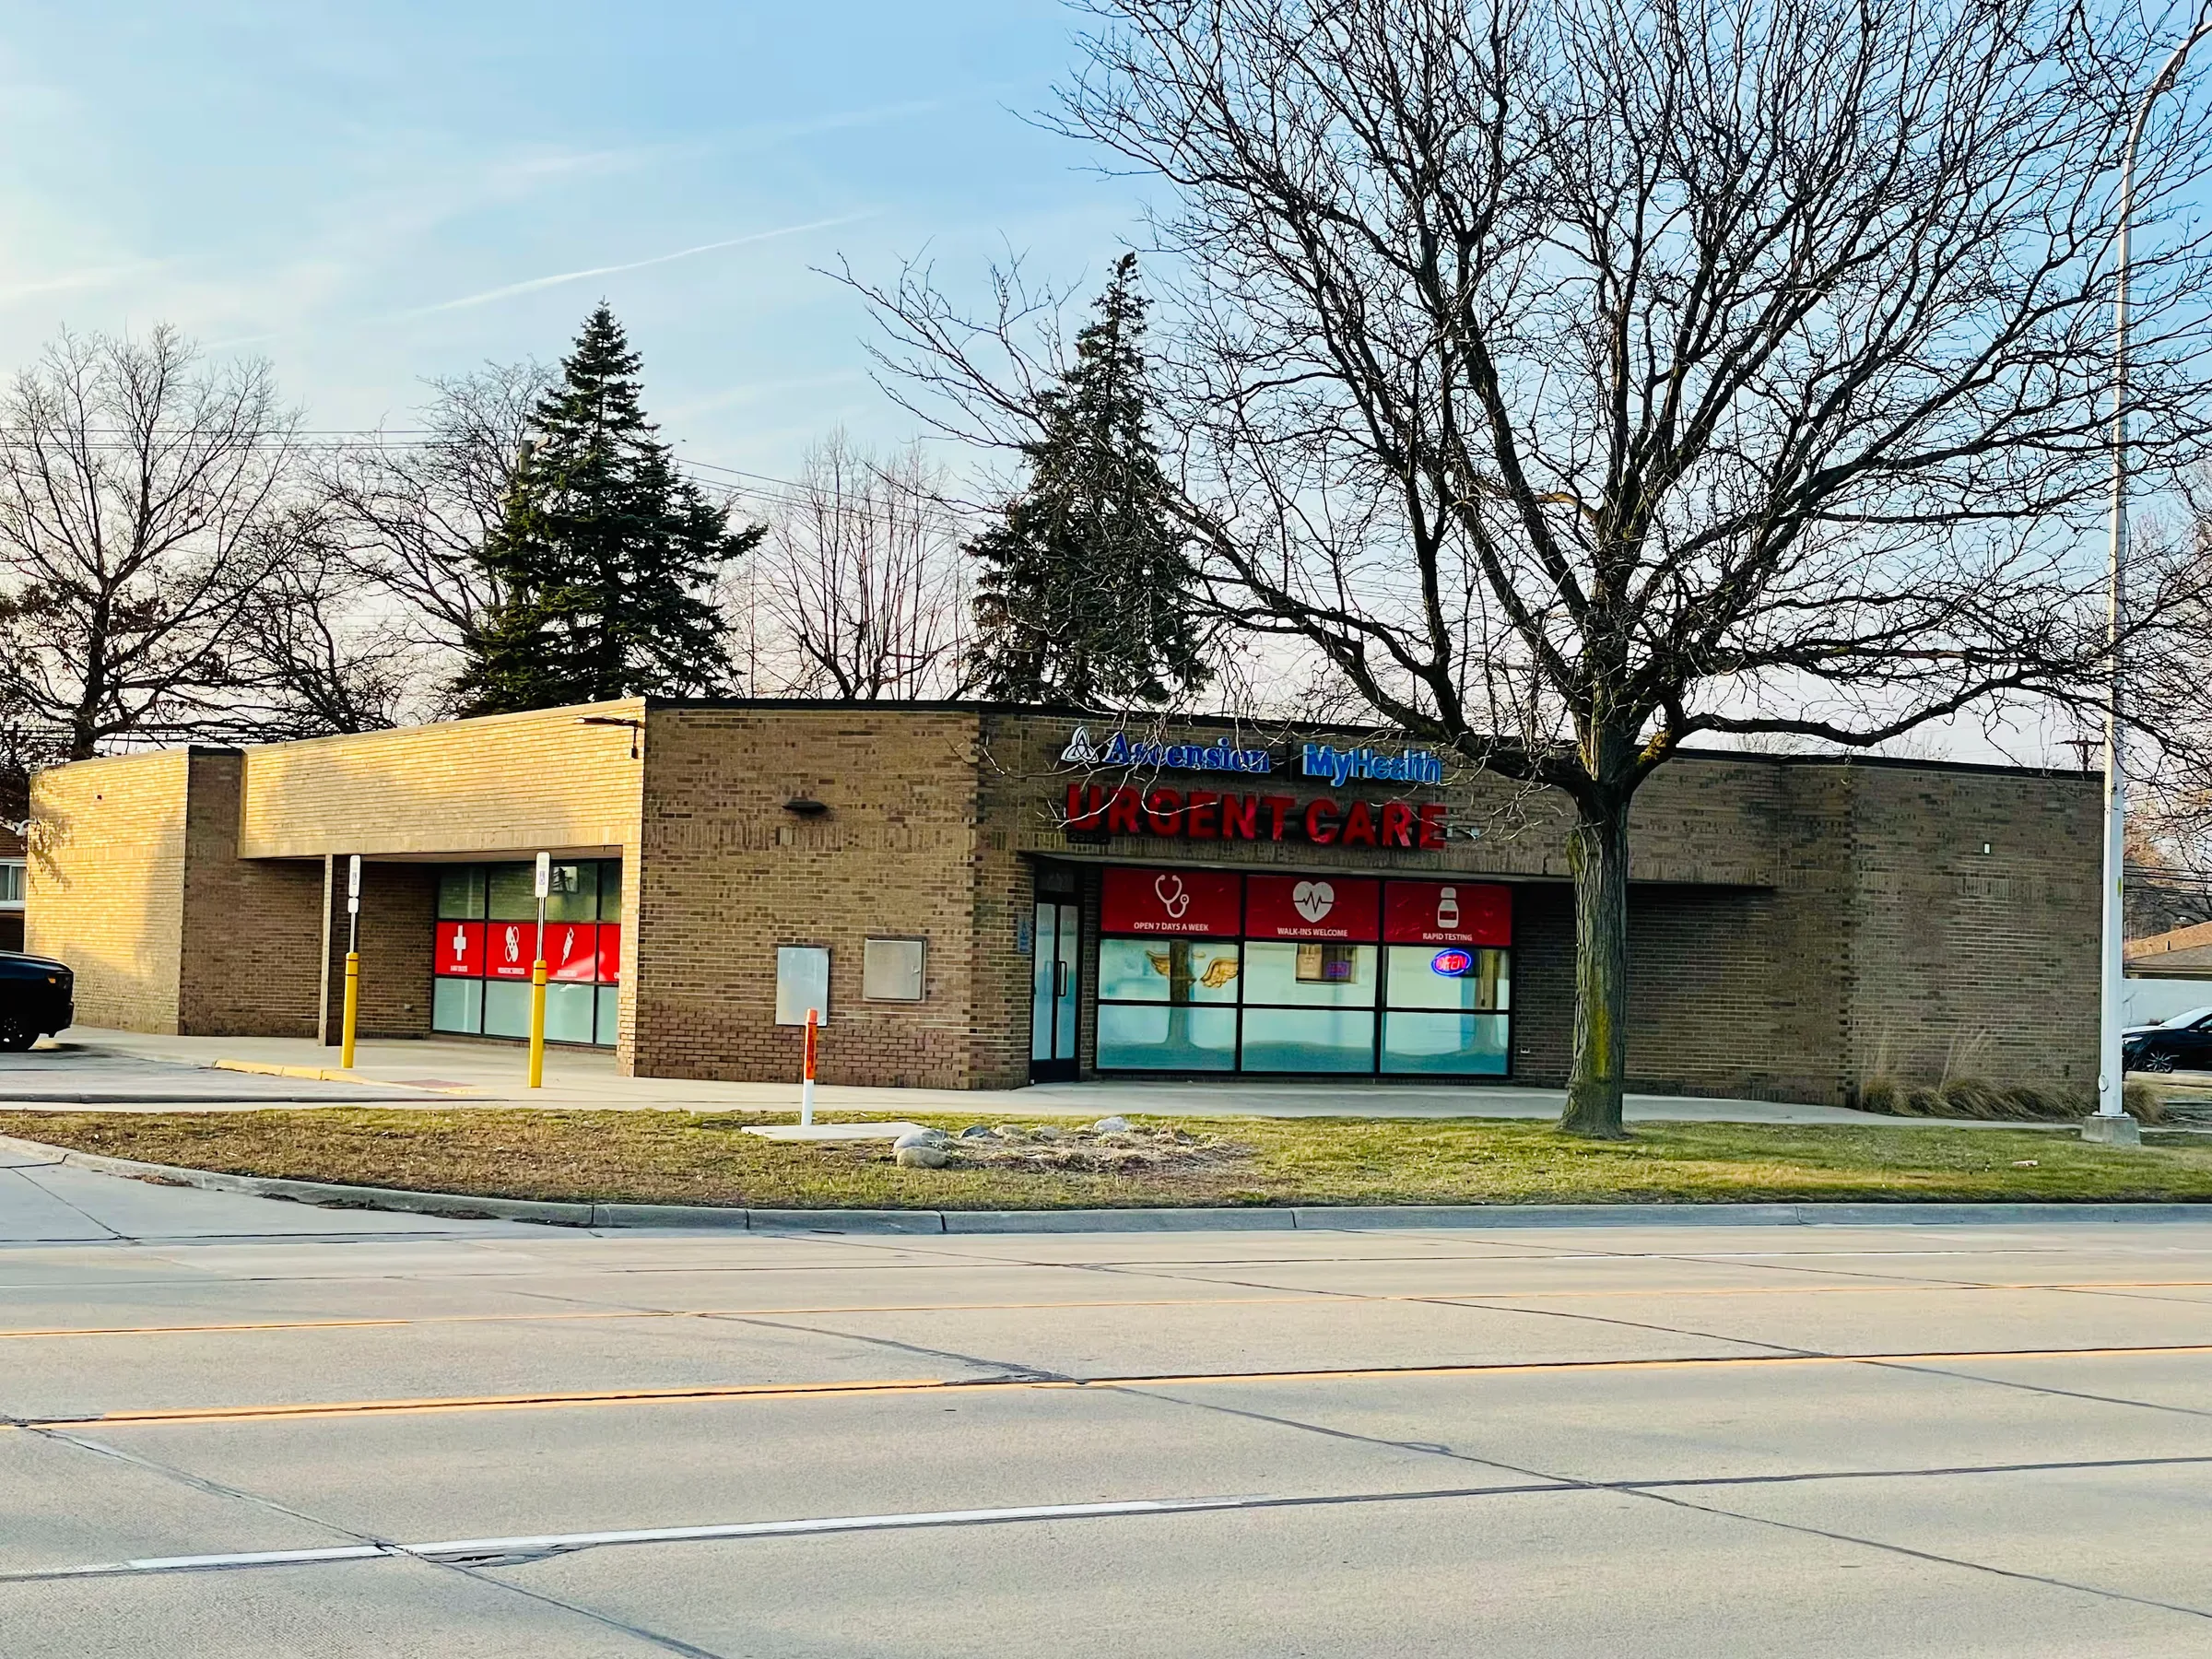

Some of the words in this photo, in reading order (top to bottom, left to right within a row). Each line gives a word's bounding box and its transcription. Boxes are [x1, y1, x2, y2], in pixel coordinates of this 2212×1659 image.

[1102, 732, 1271, 773] Ascension
[1302, 743, 1443, 787] MyHealth
[1066, 782, 1296, 842] URGENT
[1305, 795, 1447, 851] CARE
[1134, 922, 1154, 930] OPEN
[1161, 922, 1180, 931] DAYS
[1182, 923, 1187, 931] A
[1188, 924, 1209, 932] WEEK
[1277, 927, 1312, 935] WALK-INS
[1312, 928, 1348, 937] WELCOME
[1444, 933, 1473, 941] TESTING
[1435, 954, 1467, 971] OPEN
